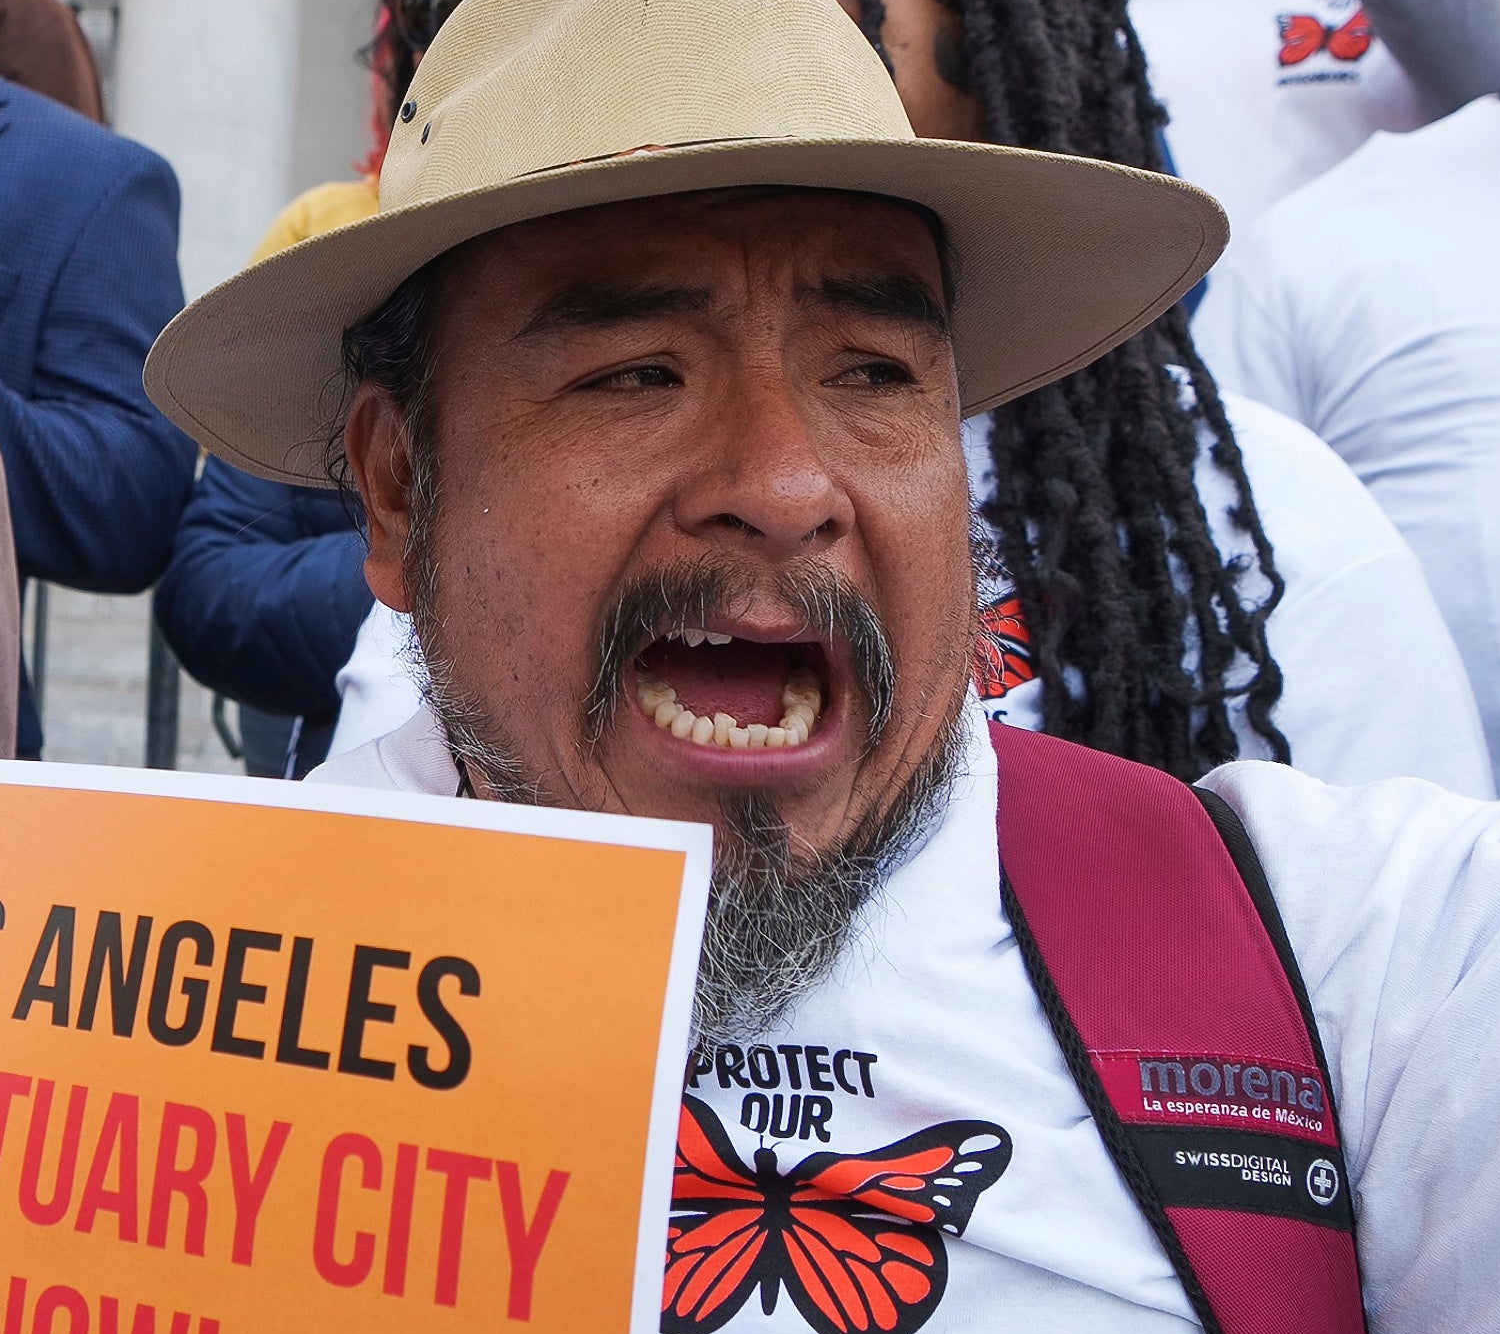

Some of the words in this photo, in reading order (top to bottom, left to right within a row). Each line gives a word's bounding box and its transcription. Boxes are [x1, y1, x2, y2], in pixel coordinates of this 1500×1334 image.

[11, 904, 482, 1091] ANGELES
[686, 1043, 878, 1098] PROTECT
[1139, 1058, 1325, 1114] morena
[739, 1093, 833, 1143] OUR
[1143, 1097, 1163, 1112] La
[1168, 1100, 1249, 1118] esperanza
[1252, 1104, 1271, 1120] de
[1275, 1108, 1323, 1132] México
[1241, 1169, 1292, 1187] DESIGN
[312, 1131, 571, 1322] CITY
